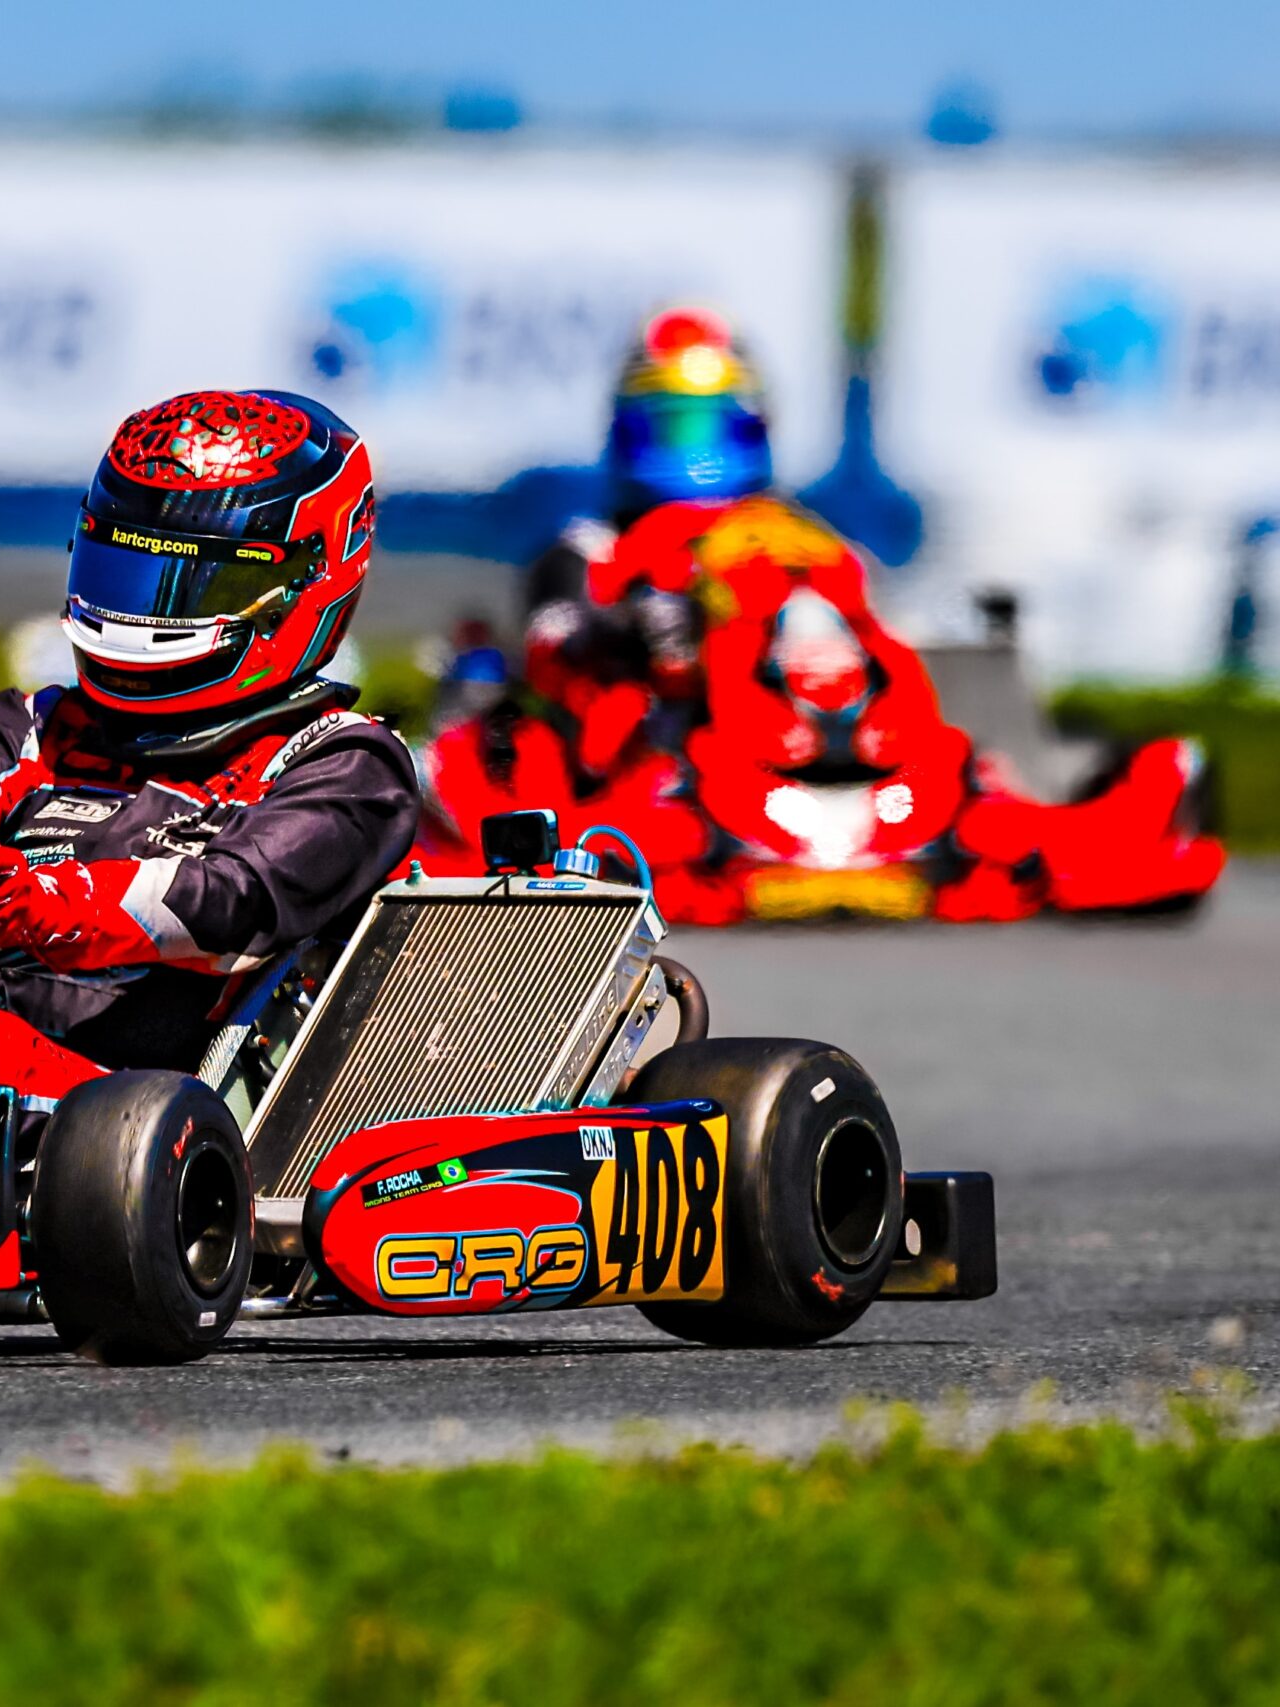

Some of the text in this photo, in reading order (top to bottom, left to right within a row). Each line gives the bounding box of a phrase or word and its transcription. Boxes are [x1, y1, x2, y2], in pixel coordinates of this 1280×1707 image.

[112, 527, 199, 555] kartcrg.com
[236, 548, 272, 562] CRG
[581, 1127, 614, 1158] OKNJ
[420, 1180, 444, 1192] CRG
[605, 1122, 720, 1295] 408
[376, 1224, 589, 1301] CRG
